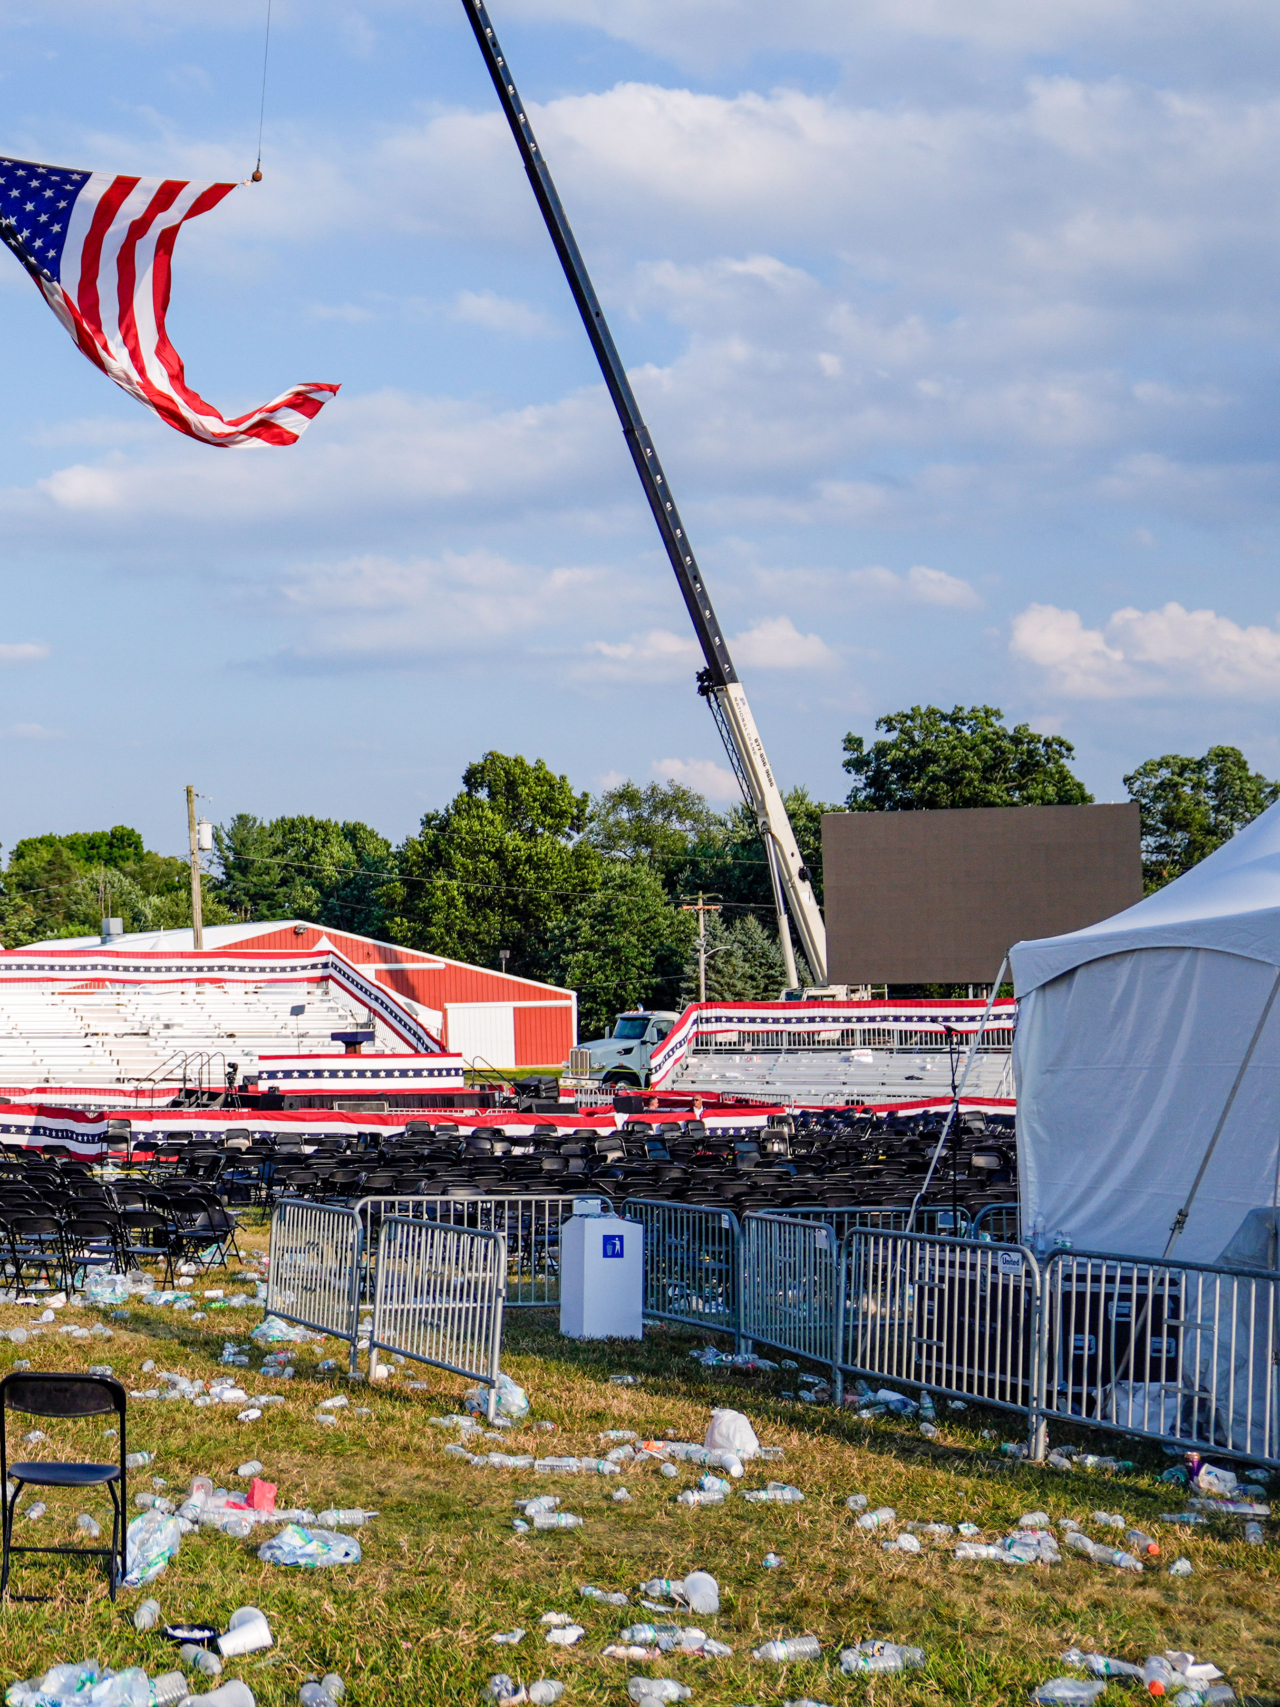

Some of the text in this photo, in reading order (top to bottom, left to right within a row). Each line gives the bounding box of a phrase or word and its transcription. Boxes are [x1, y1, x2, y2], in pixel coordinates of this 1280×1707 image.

[733, 697, 757, 756] NATIONAL CRANE
[1002, 1257, 1020, 1266] United
